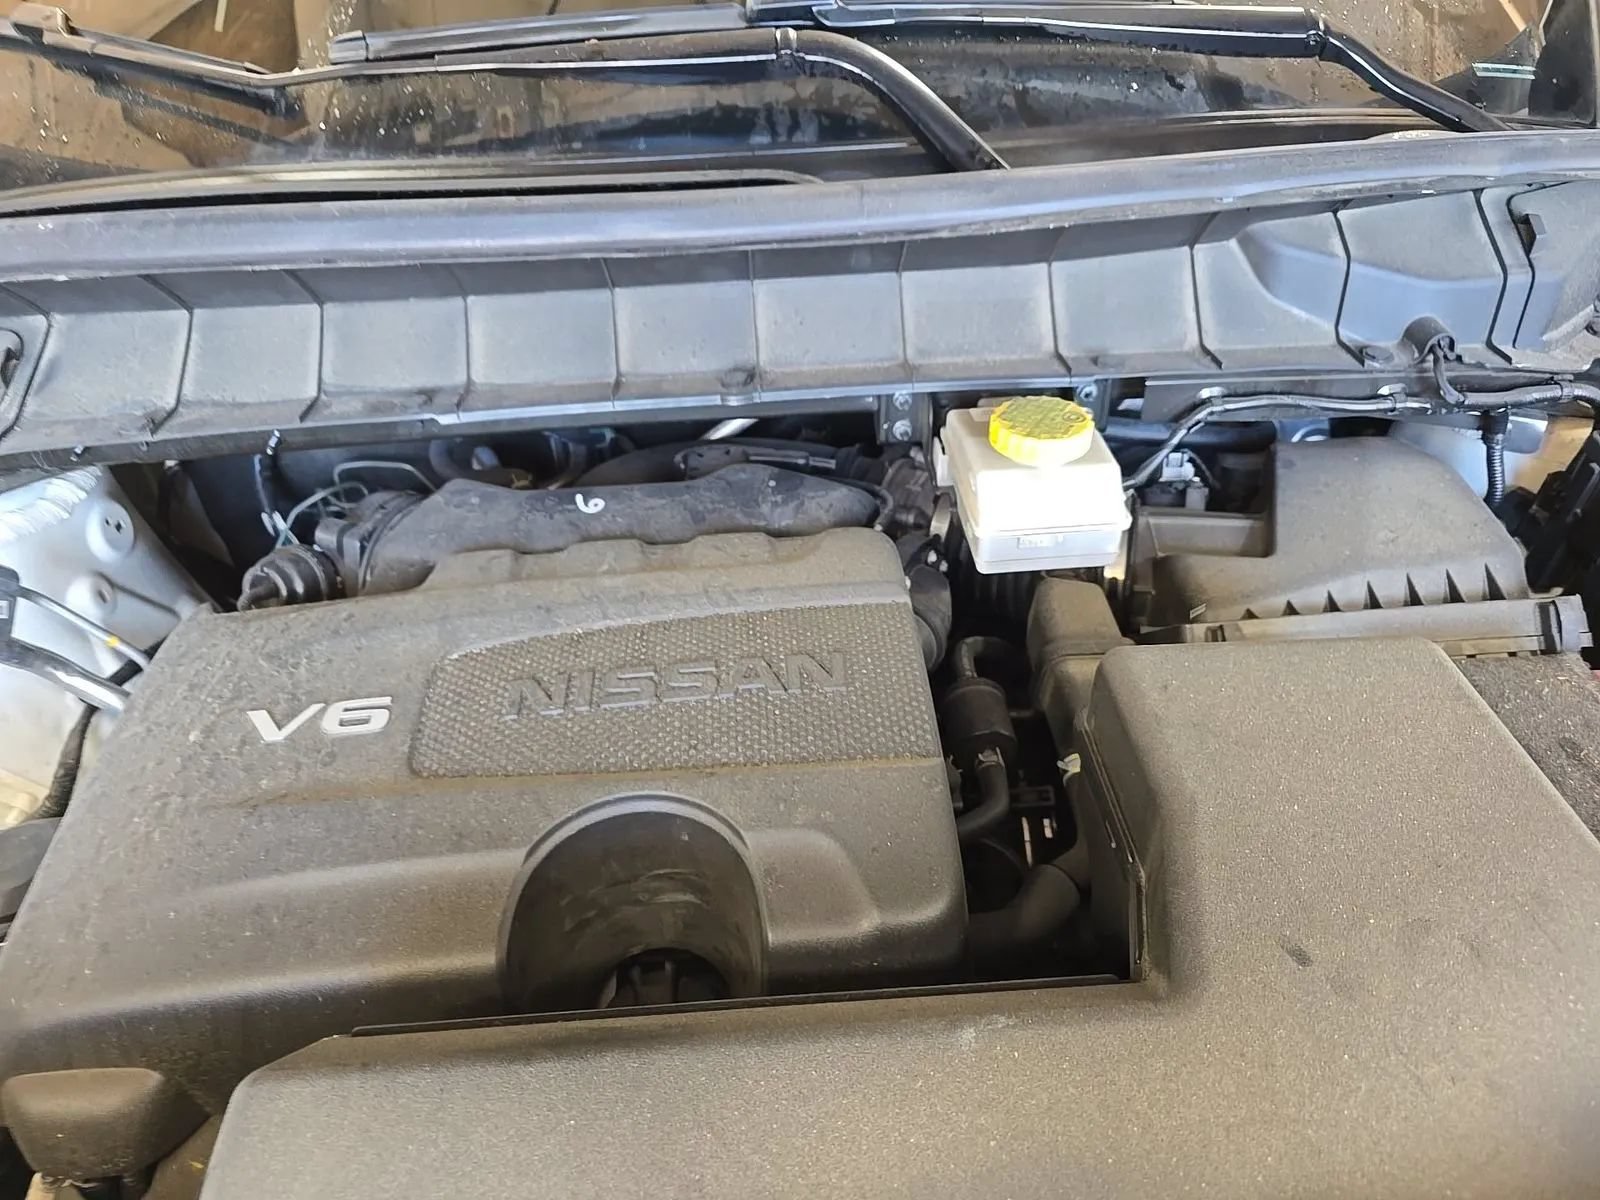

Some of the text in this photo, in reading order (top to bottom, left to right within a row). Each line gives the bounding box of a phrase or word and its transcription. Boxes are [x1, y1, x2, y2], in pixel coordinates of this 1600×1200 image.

[575, 493, 606, 514] 6
[501, 651, 848, 721] NISSAN
[246, 695, 393, 743] V6
